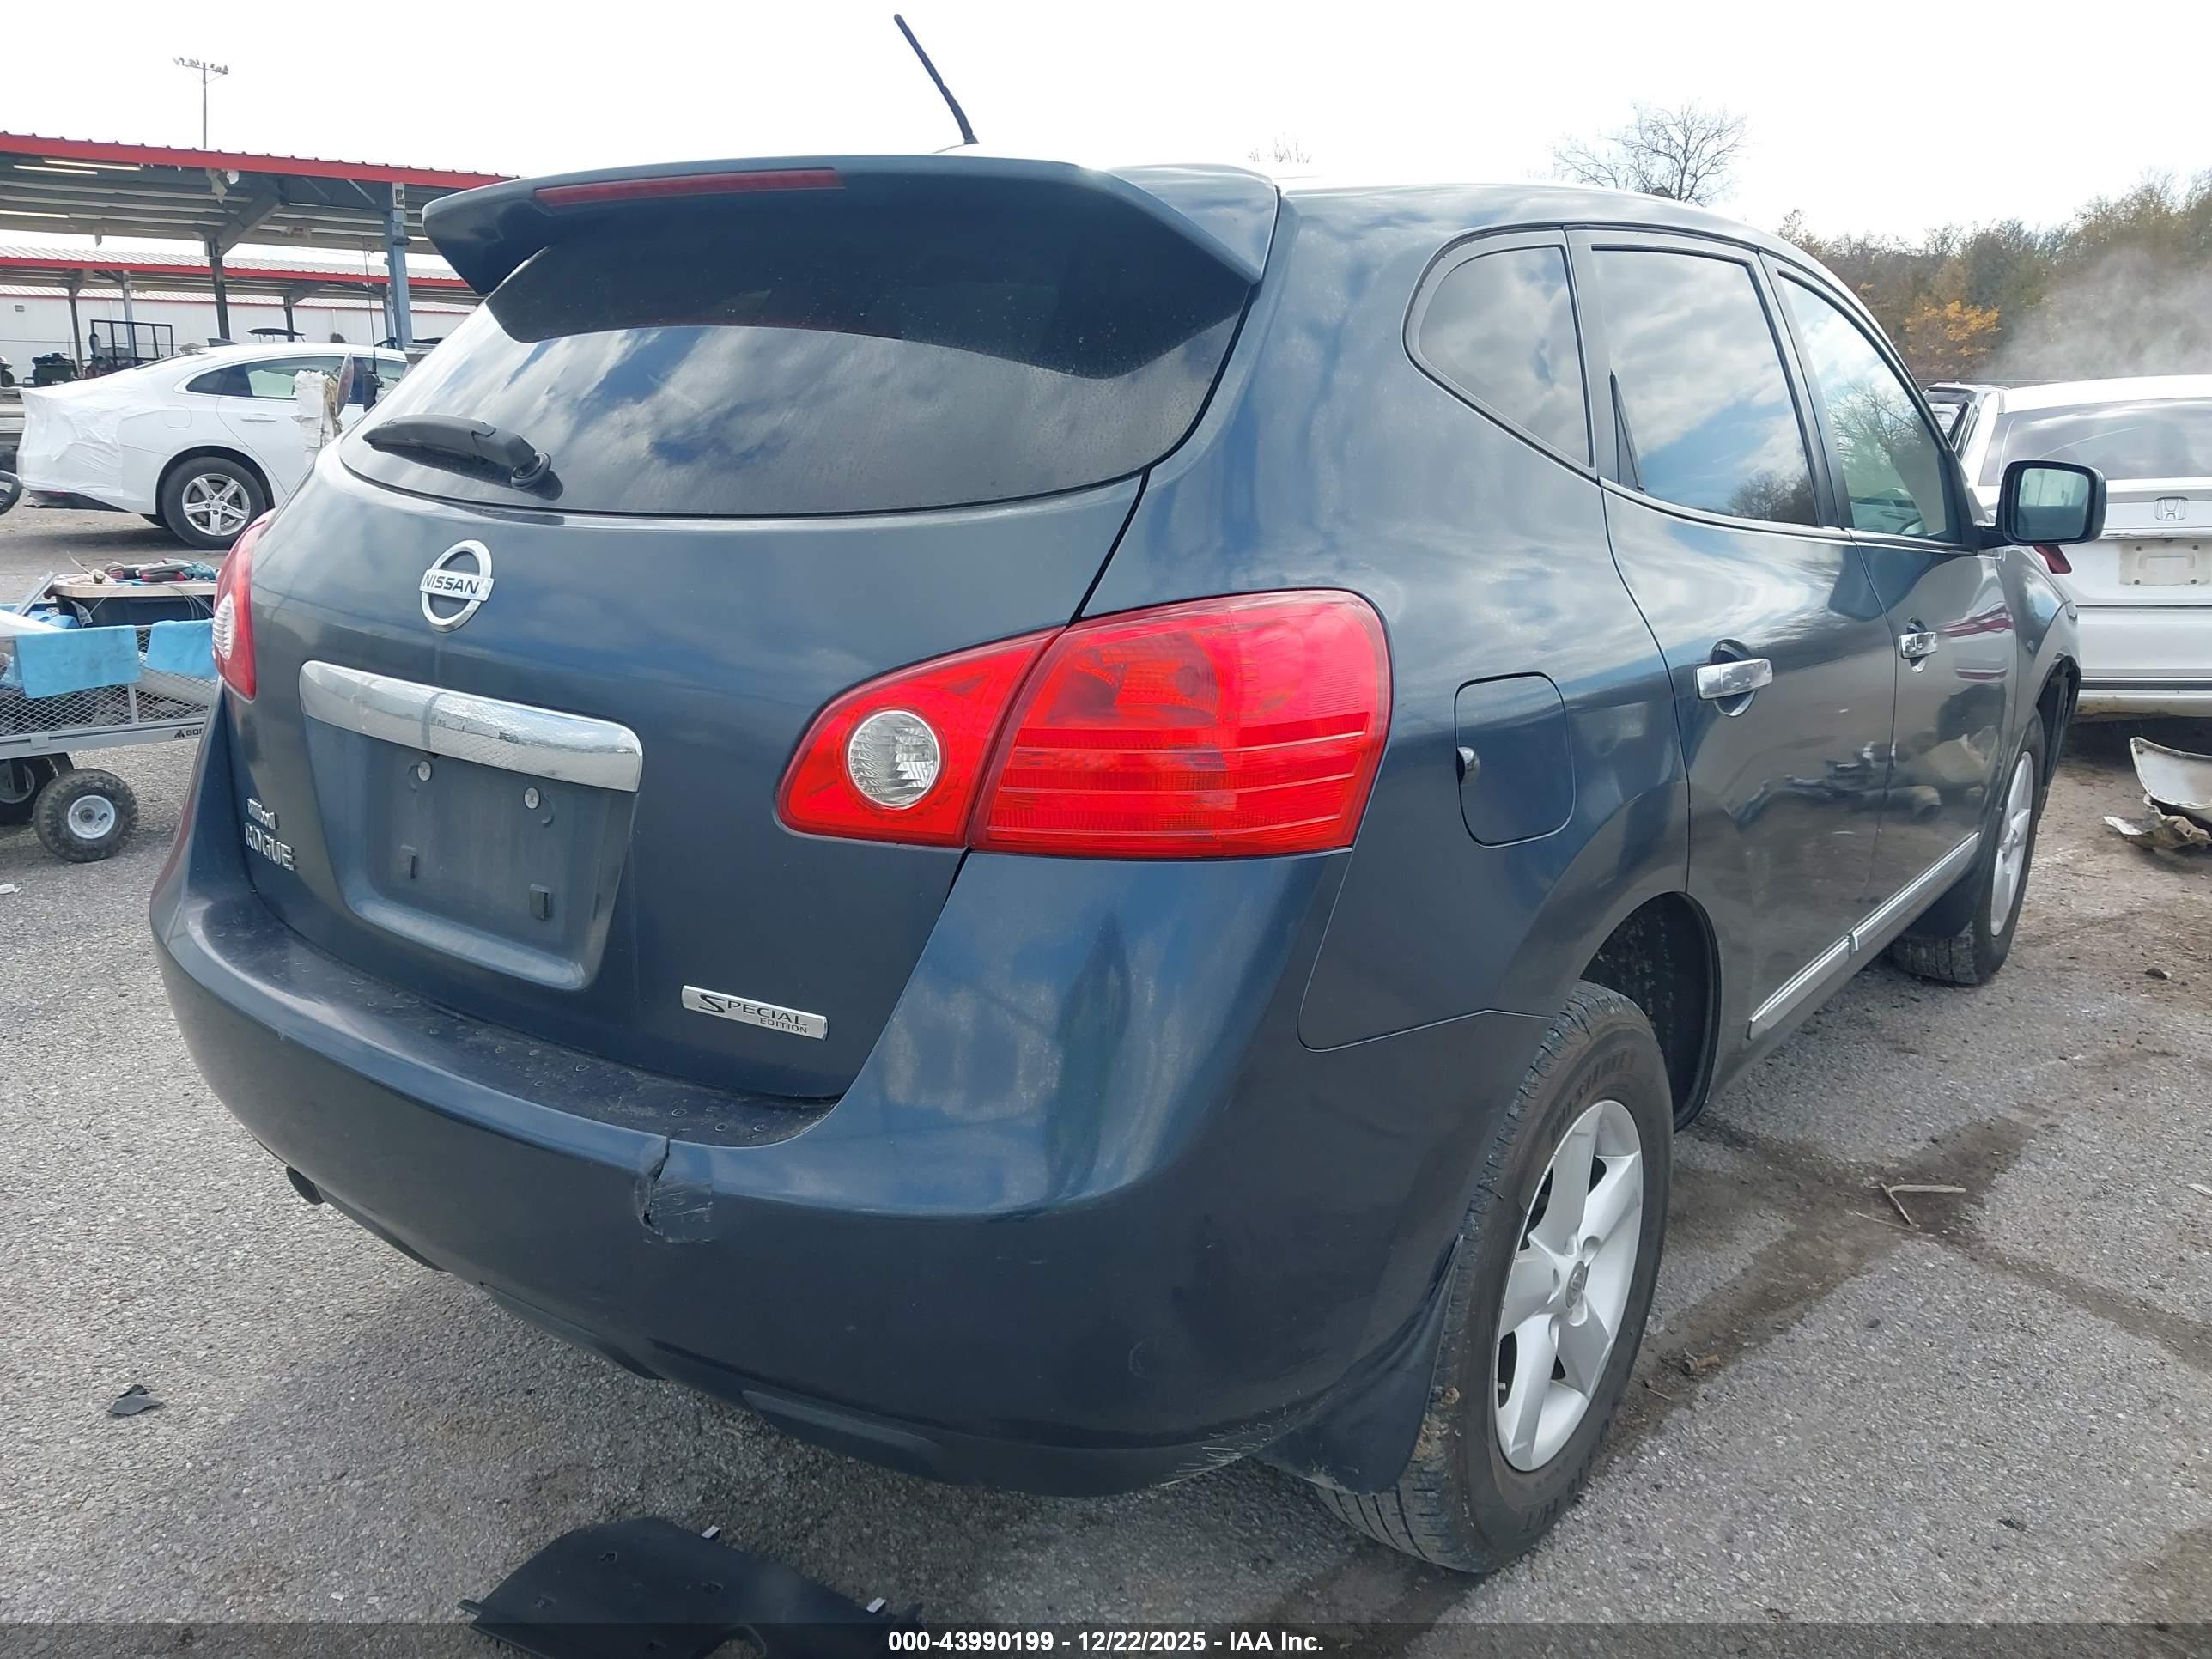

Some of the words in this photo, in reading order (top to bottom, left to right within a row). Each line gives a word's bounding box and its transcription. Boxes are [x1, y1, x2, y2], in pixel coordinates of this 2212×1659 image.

[422, 574, 480, 595] NISSAN
[245, 822, 295, 871] ROGUE
[698, 994, 808, 1027] SPECIAL
[759, 1017, 808, 1034] EDITION
